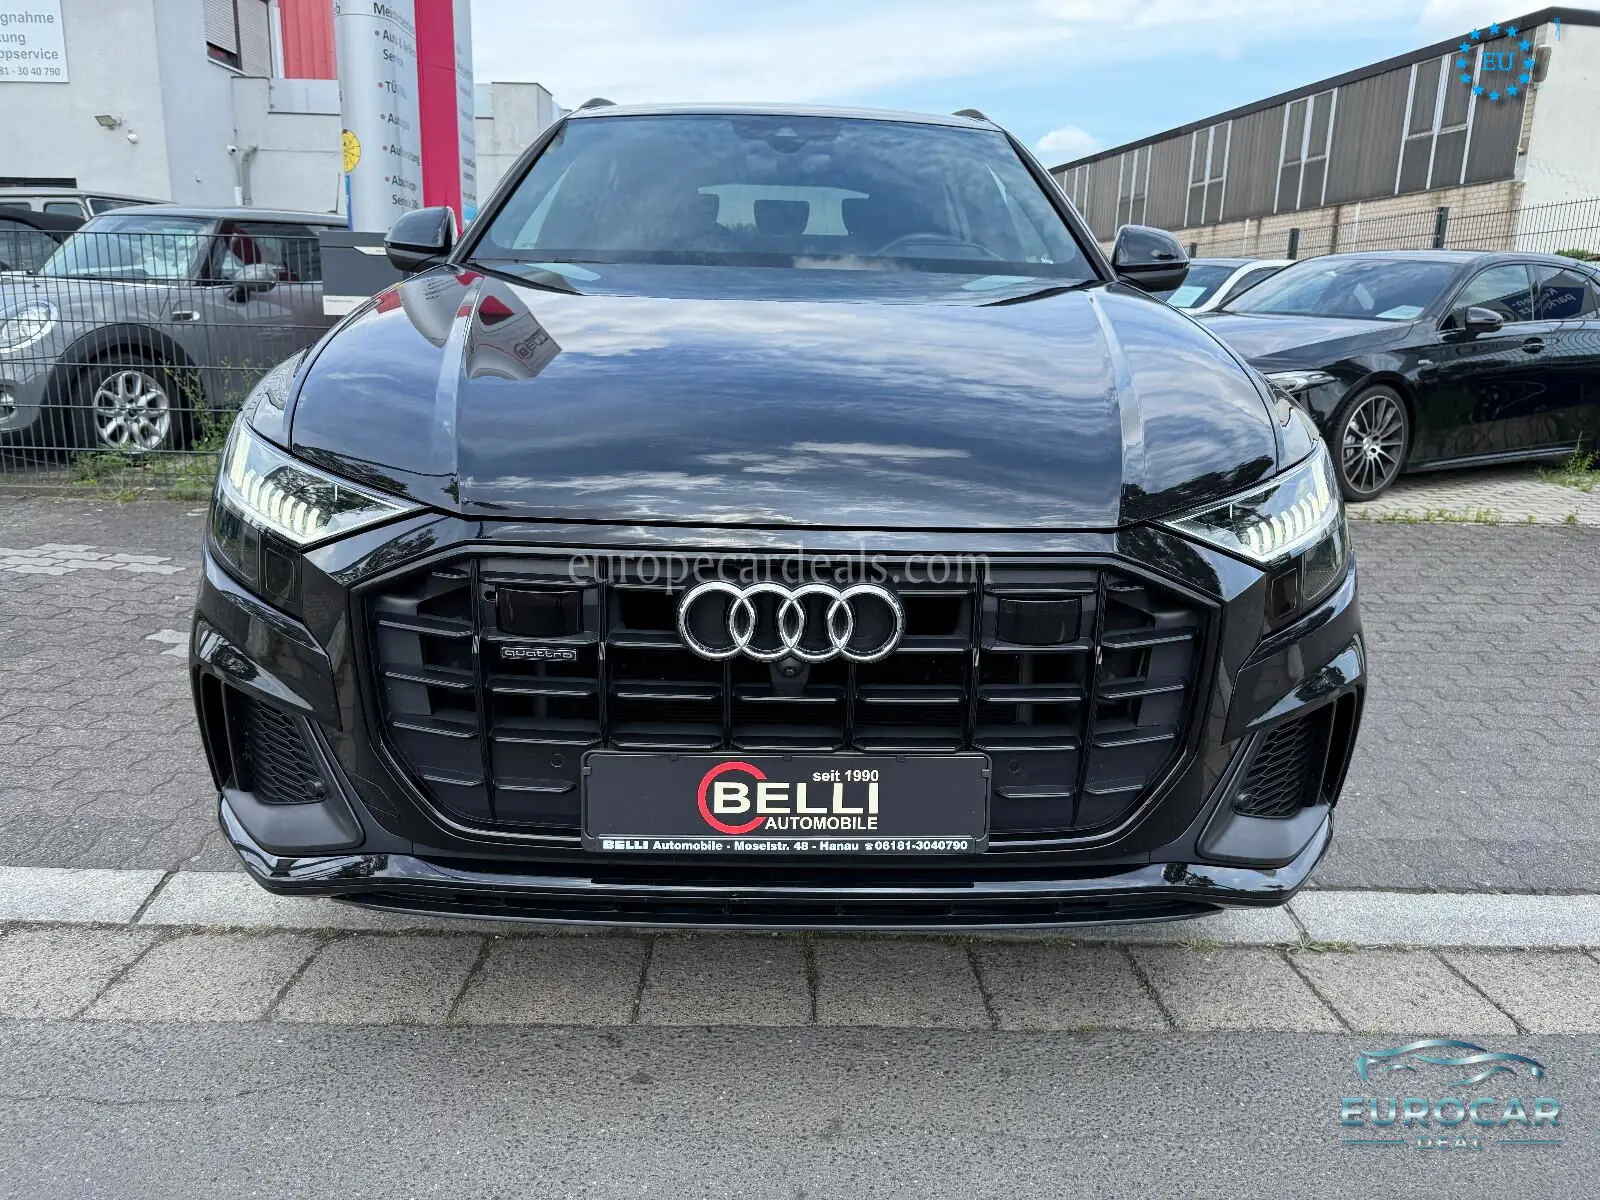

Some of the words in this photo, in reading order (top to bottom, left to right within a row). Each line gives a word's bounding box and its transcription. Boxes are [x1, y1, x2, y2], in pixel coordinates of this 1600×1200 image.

[17, 66, 29, 76] 30
[31, 67, 42, 76] 40
[44, 67, 60, 76] 790
[504, 649, 573, 659] quattro
[812, 769, 841, 782] seit
[845, 769, 879, 782] 1990
[713, 781, 879, 814] BELLI
[764, 816, 878, 830] AUTOMOBILE
[602, 840, 649, 850] BELLI
[652, 840, 723, 851] Automobile
[734, 841, 790, 851] Moselstr.
[793, 841, 809, 851] 48
[820, 841, 859, 851] Hanau
